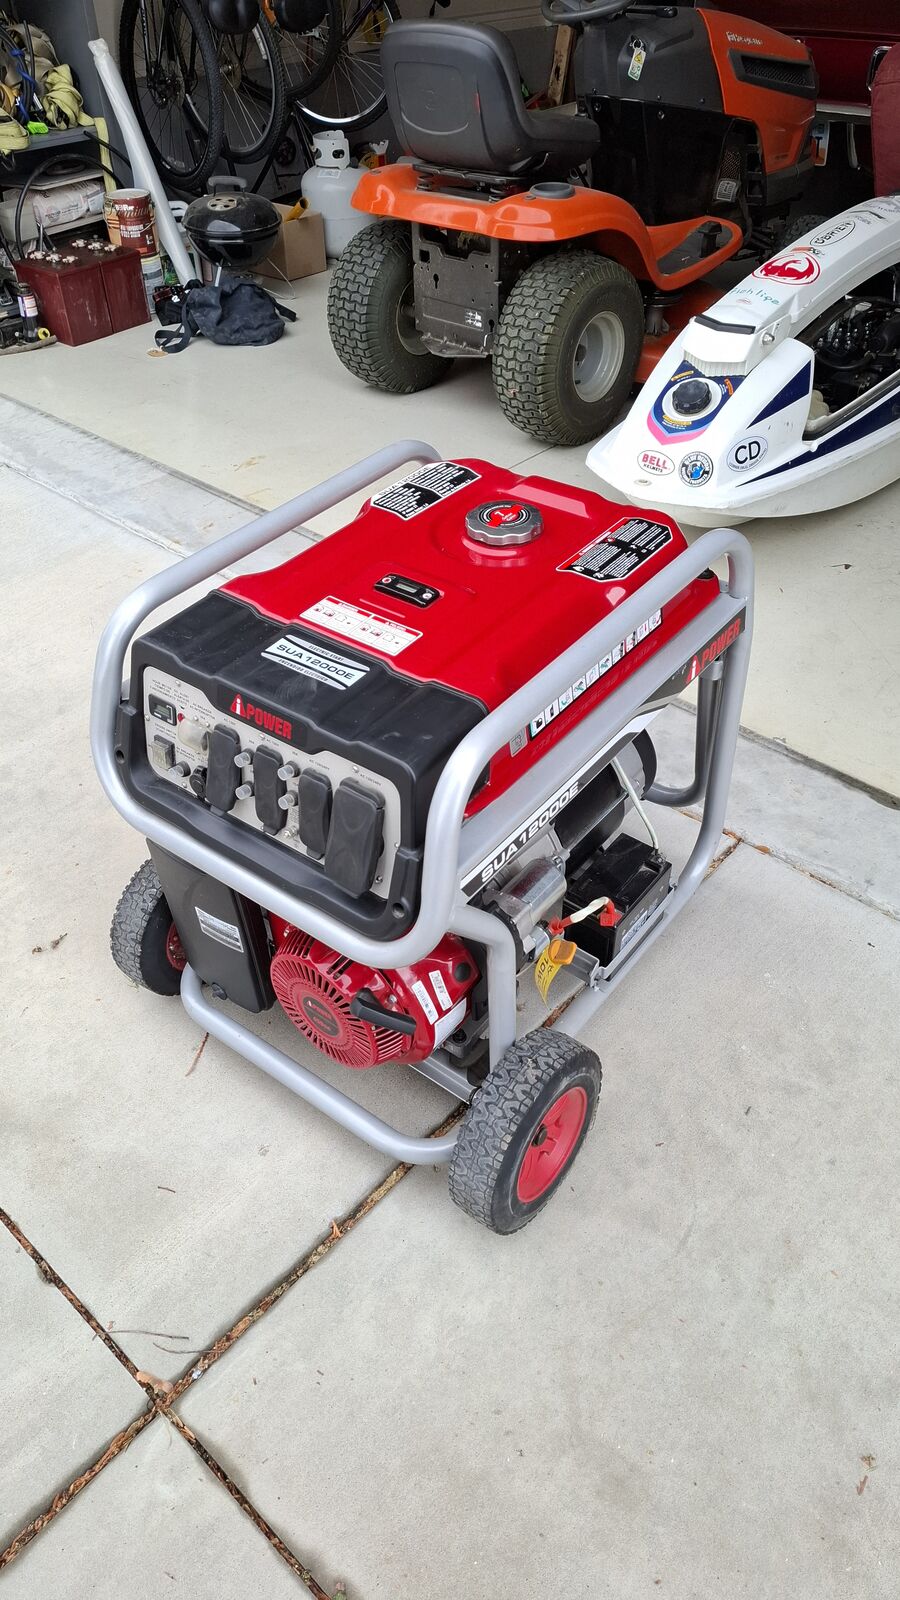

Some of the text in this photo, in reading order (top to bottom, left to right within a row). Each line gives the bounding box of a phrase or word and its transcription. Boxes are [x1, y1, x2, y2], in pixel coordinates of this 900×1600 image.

[734, 440, 761, 465] CD
[642, 453, 668, 469] BELL
[643, 463, 664, 473] HELMETS
[308, 645, 329, 656] ELECTRIC
